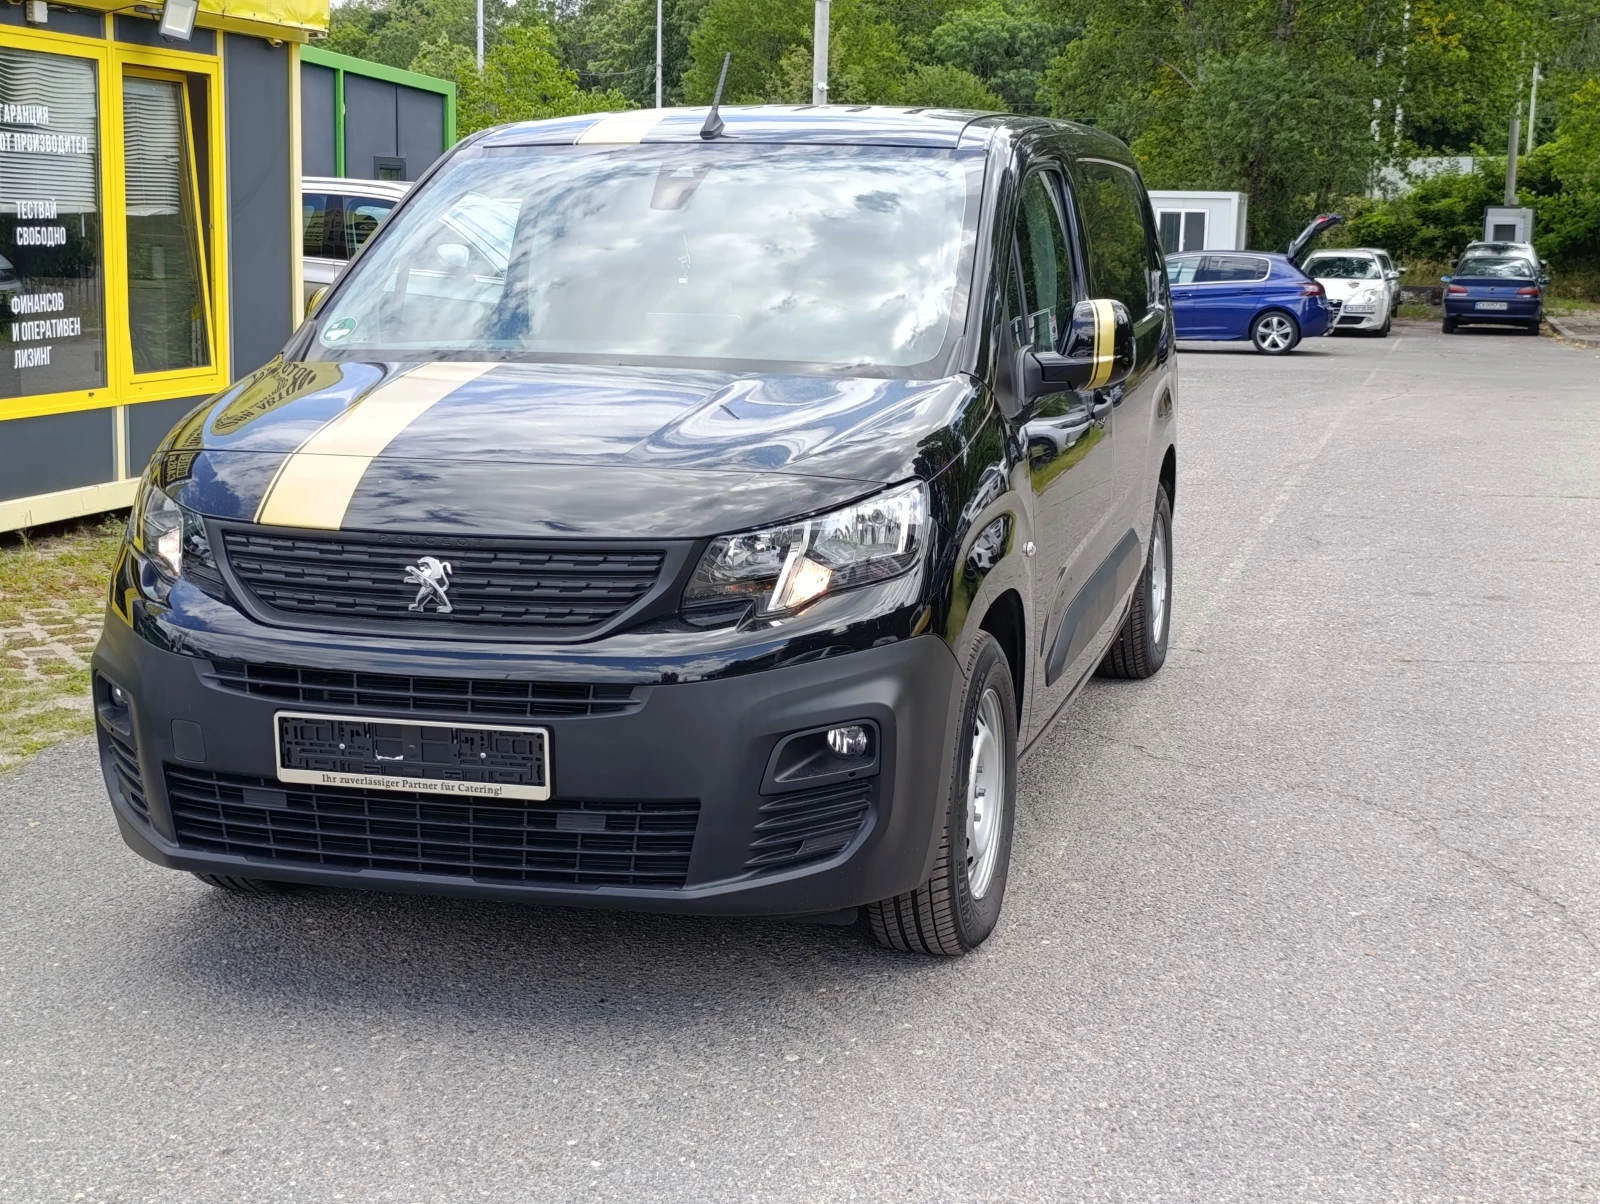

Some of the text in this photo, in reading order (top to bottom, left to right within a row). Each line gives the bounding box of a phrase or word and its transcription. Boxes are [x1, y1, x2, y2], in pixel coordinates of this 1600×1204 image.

[0, 132, 88, 155] ОТ ПРОИЗВОДИТЕЛ
[16, 198, 57, 219] ТЕСТВАЙ
[16, 226, 67, 247] СВОБОДНО
[11, 292, 64, 314] ФИНАНСОВ
[12, 317, 81, 342] И ОПЕРАТИВЕН
[14, 346, 52, 369] ЛИЗИНГ
[379, 534, 484, 547] PEUGEOT
[321, 773, 503, 796] Ihr zuverlässiger Partner für Catering!
